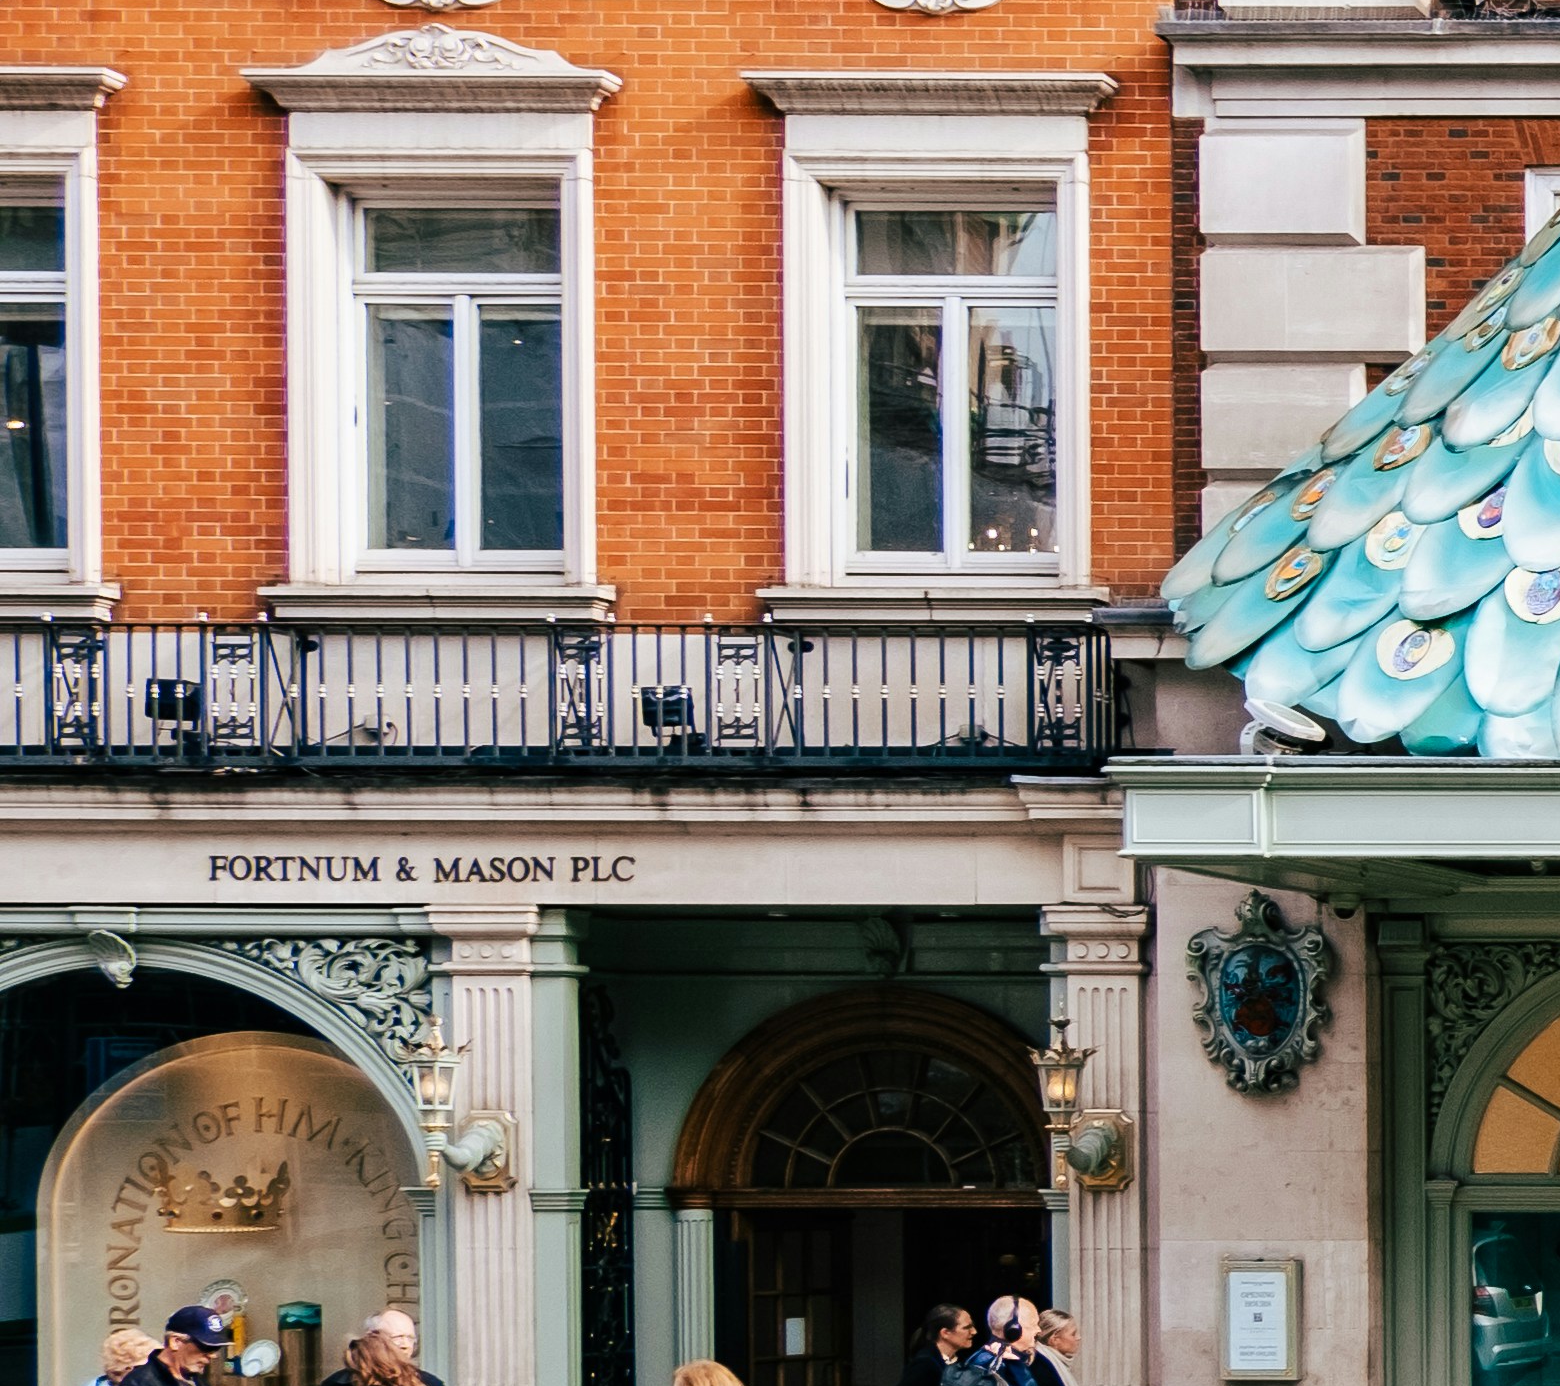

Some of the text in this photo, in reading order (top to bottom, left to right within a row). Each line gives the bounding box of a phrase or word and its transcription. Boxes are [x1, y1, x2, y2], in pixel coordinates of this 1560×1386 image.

[209, 855, 636, 882] FORTNUM & MASON PLC
[191, 1101, 241, 1144] OF
[345, 1135, 419, 1242] KING
